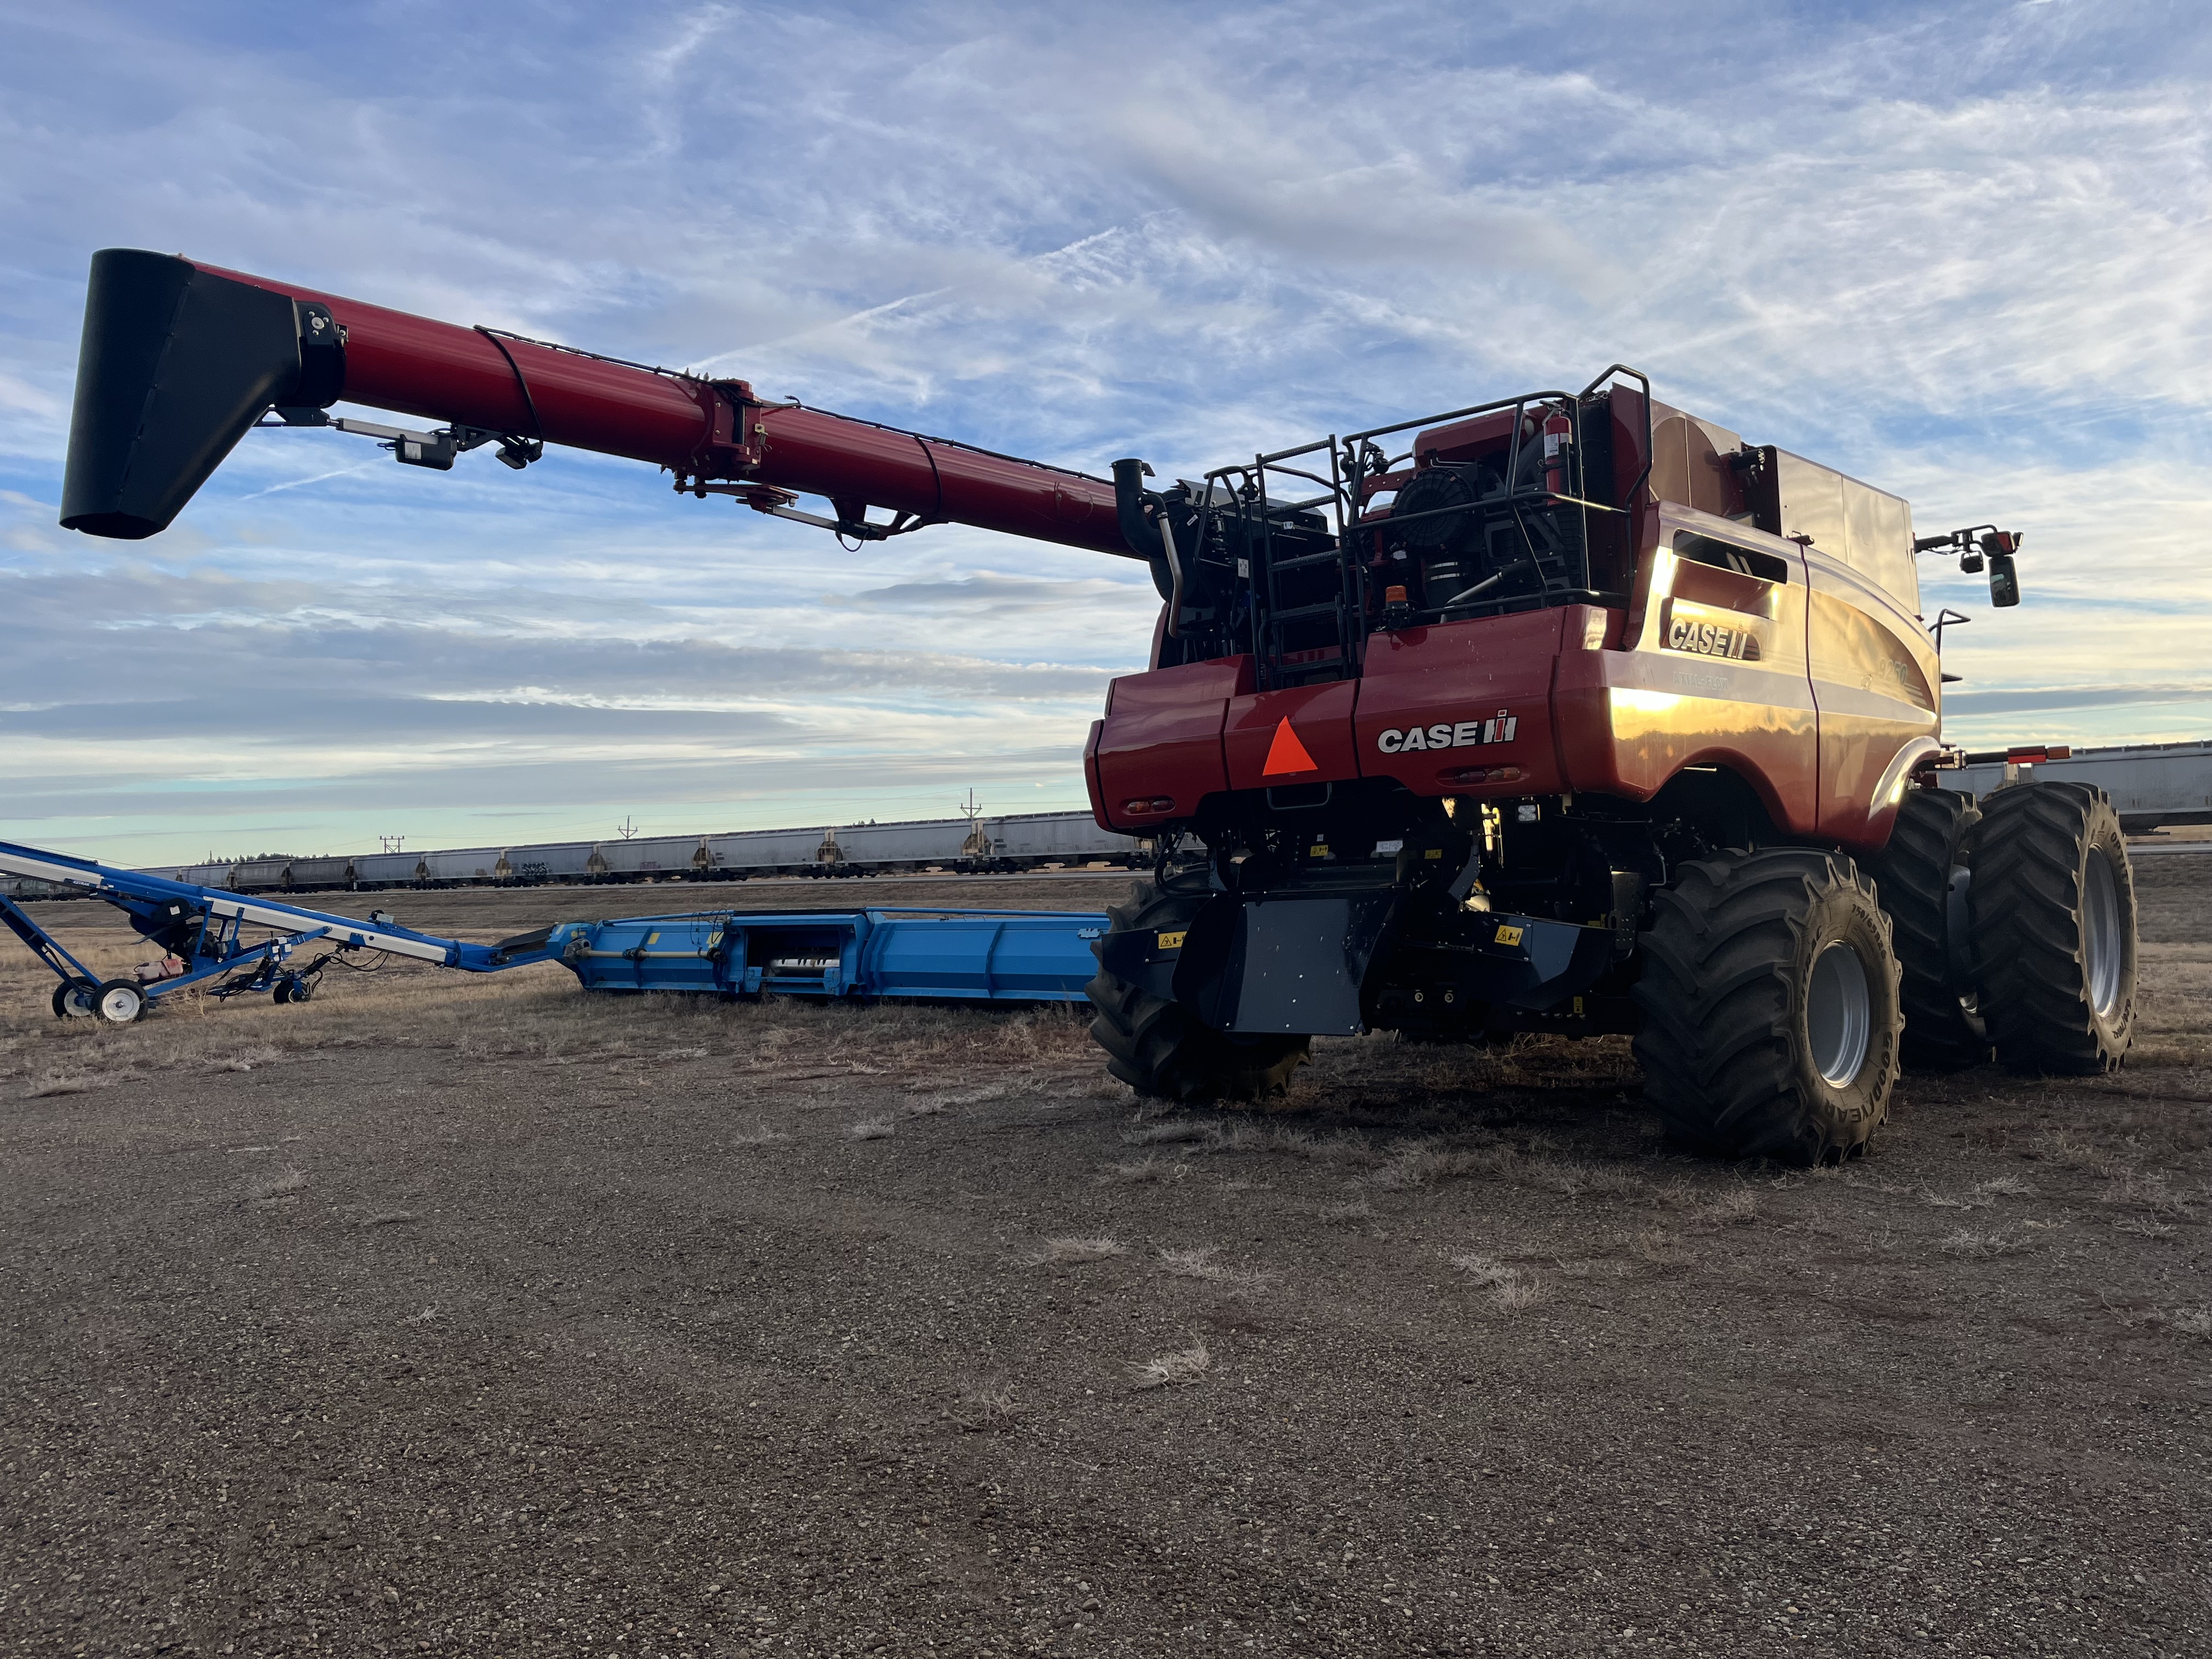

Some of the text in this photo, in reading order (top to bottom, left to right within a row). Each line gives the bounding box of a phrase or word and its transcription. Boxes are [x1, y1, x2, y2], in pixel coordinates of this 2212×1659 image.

[1669, 617, 1729, 656] CASE
[1673, 671, 1728, 691] AXIAL-FLOW
[1878, 658, 1908, 686] 9250
[1378, 721, 1478, 753] CASE
[1851, 903, 1887, 960] 750/65R26
[1824, 1030, 1893, 1124] GOODYEAR
